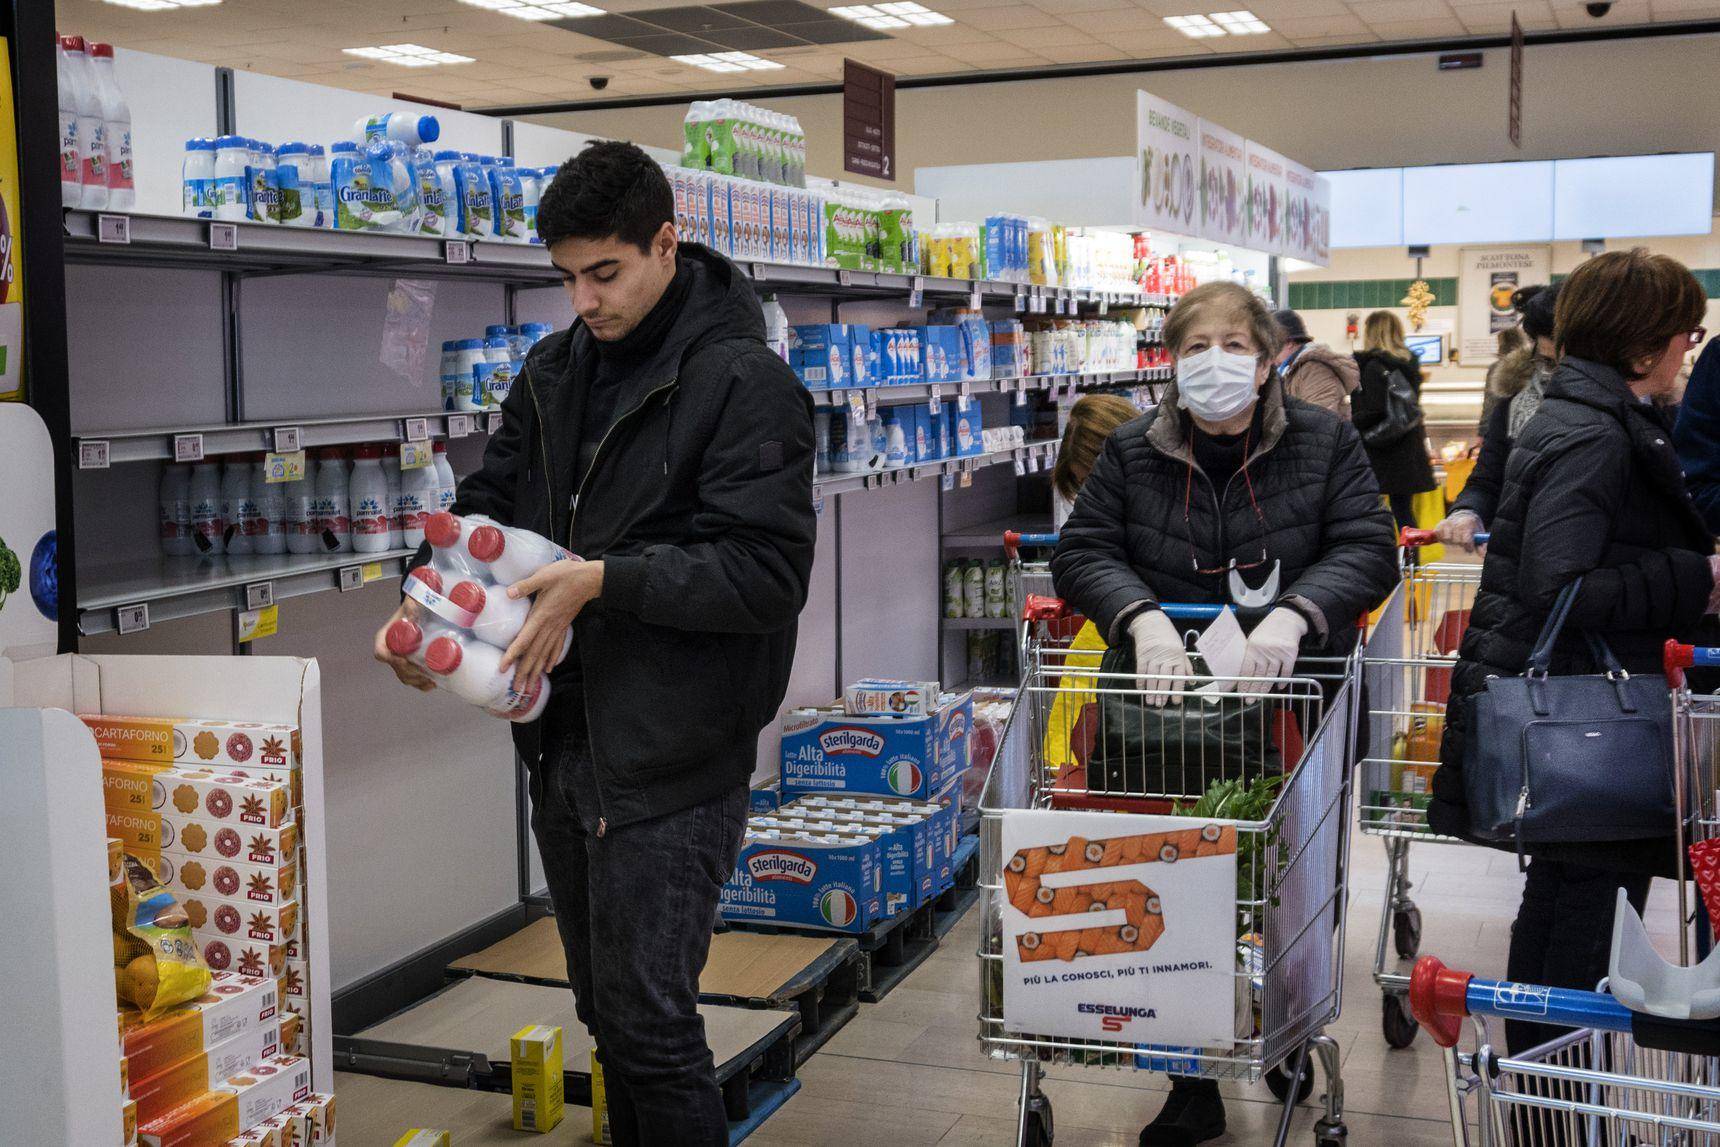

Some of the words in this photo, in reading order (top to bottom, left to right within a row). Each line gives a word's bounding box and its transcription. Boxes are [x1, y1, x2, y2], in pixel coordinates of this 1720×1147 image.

[1149, 109, 1169, 132] BEVANDE
[883, 155, 889, 175] 2
[784, 718, 819, 733] Microfiltrato
[824, 732, 880, 751] sterilgarda
[264, 756, 283, 764] FRIO
[799, 745, 824, 761] Alta
[786, 760, 846, 777] Digeribilità
[243, 814, 262, 823] FRIO
[252, 854, 271, 862] FRIO
[752, 855, 812, 877] sterilgarda
[250, 892, 270, 900] FRIO
[720, 886, 776, 904] igeribilità
[251, 932, 270, 940] FRIO
[241, 967, 260, 976] FRIO
[1024, 975, 1041, 985] PIÙ
[1044, 974, 1058, 984] LA
[1062, 970, 1114, 983] CONOSCI,
[1117, 965, 1135, 977] PIÙ
[1139, 966, 1149, 975] TI
[1153, 961, 1213, 974] INNAMORI.
[261, 1008, 274, 1019] FRIO
[1077, 1002, 1156, 1018] ESSELUNGA
[263, 1045, 276, 1058] FRIO
[294, 1088, 307, 1100] FRIO
